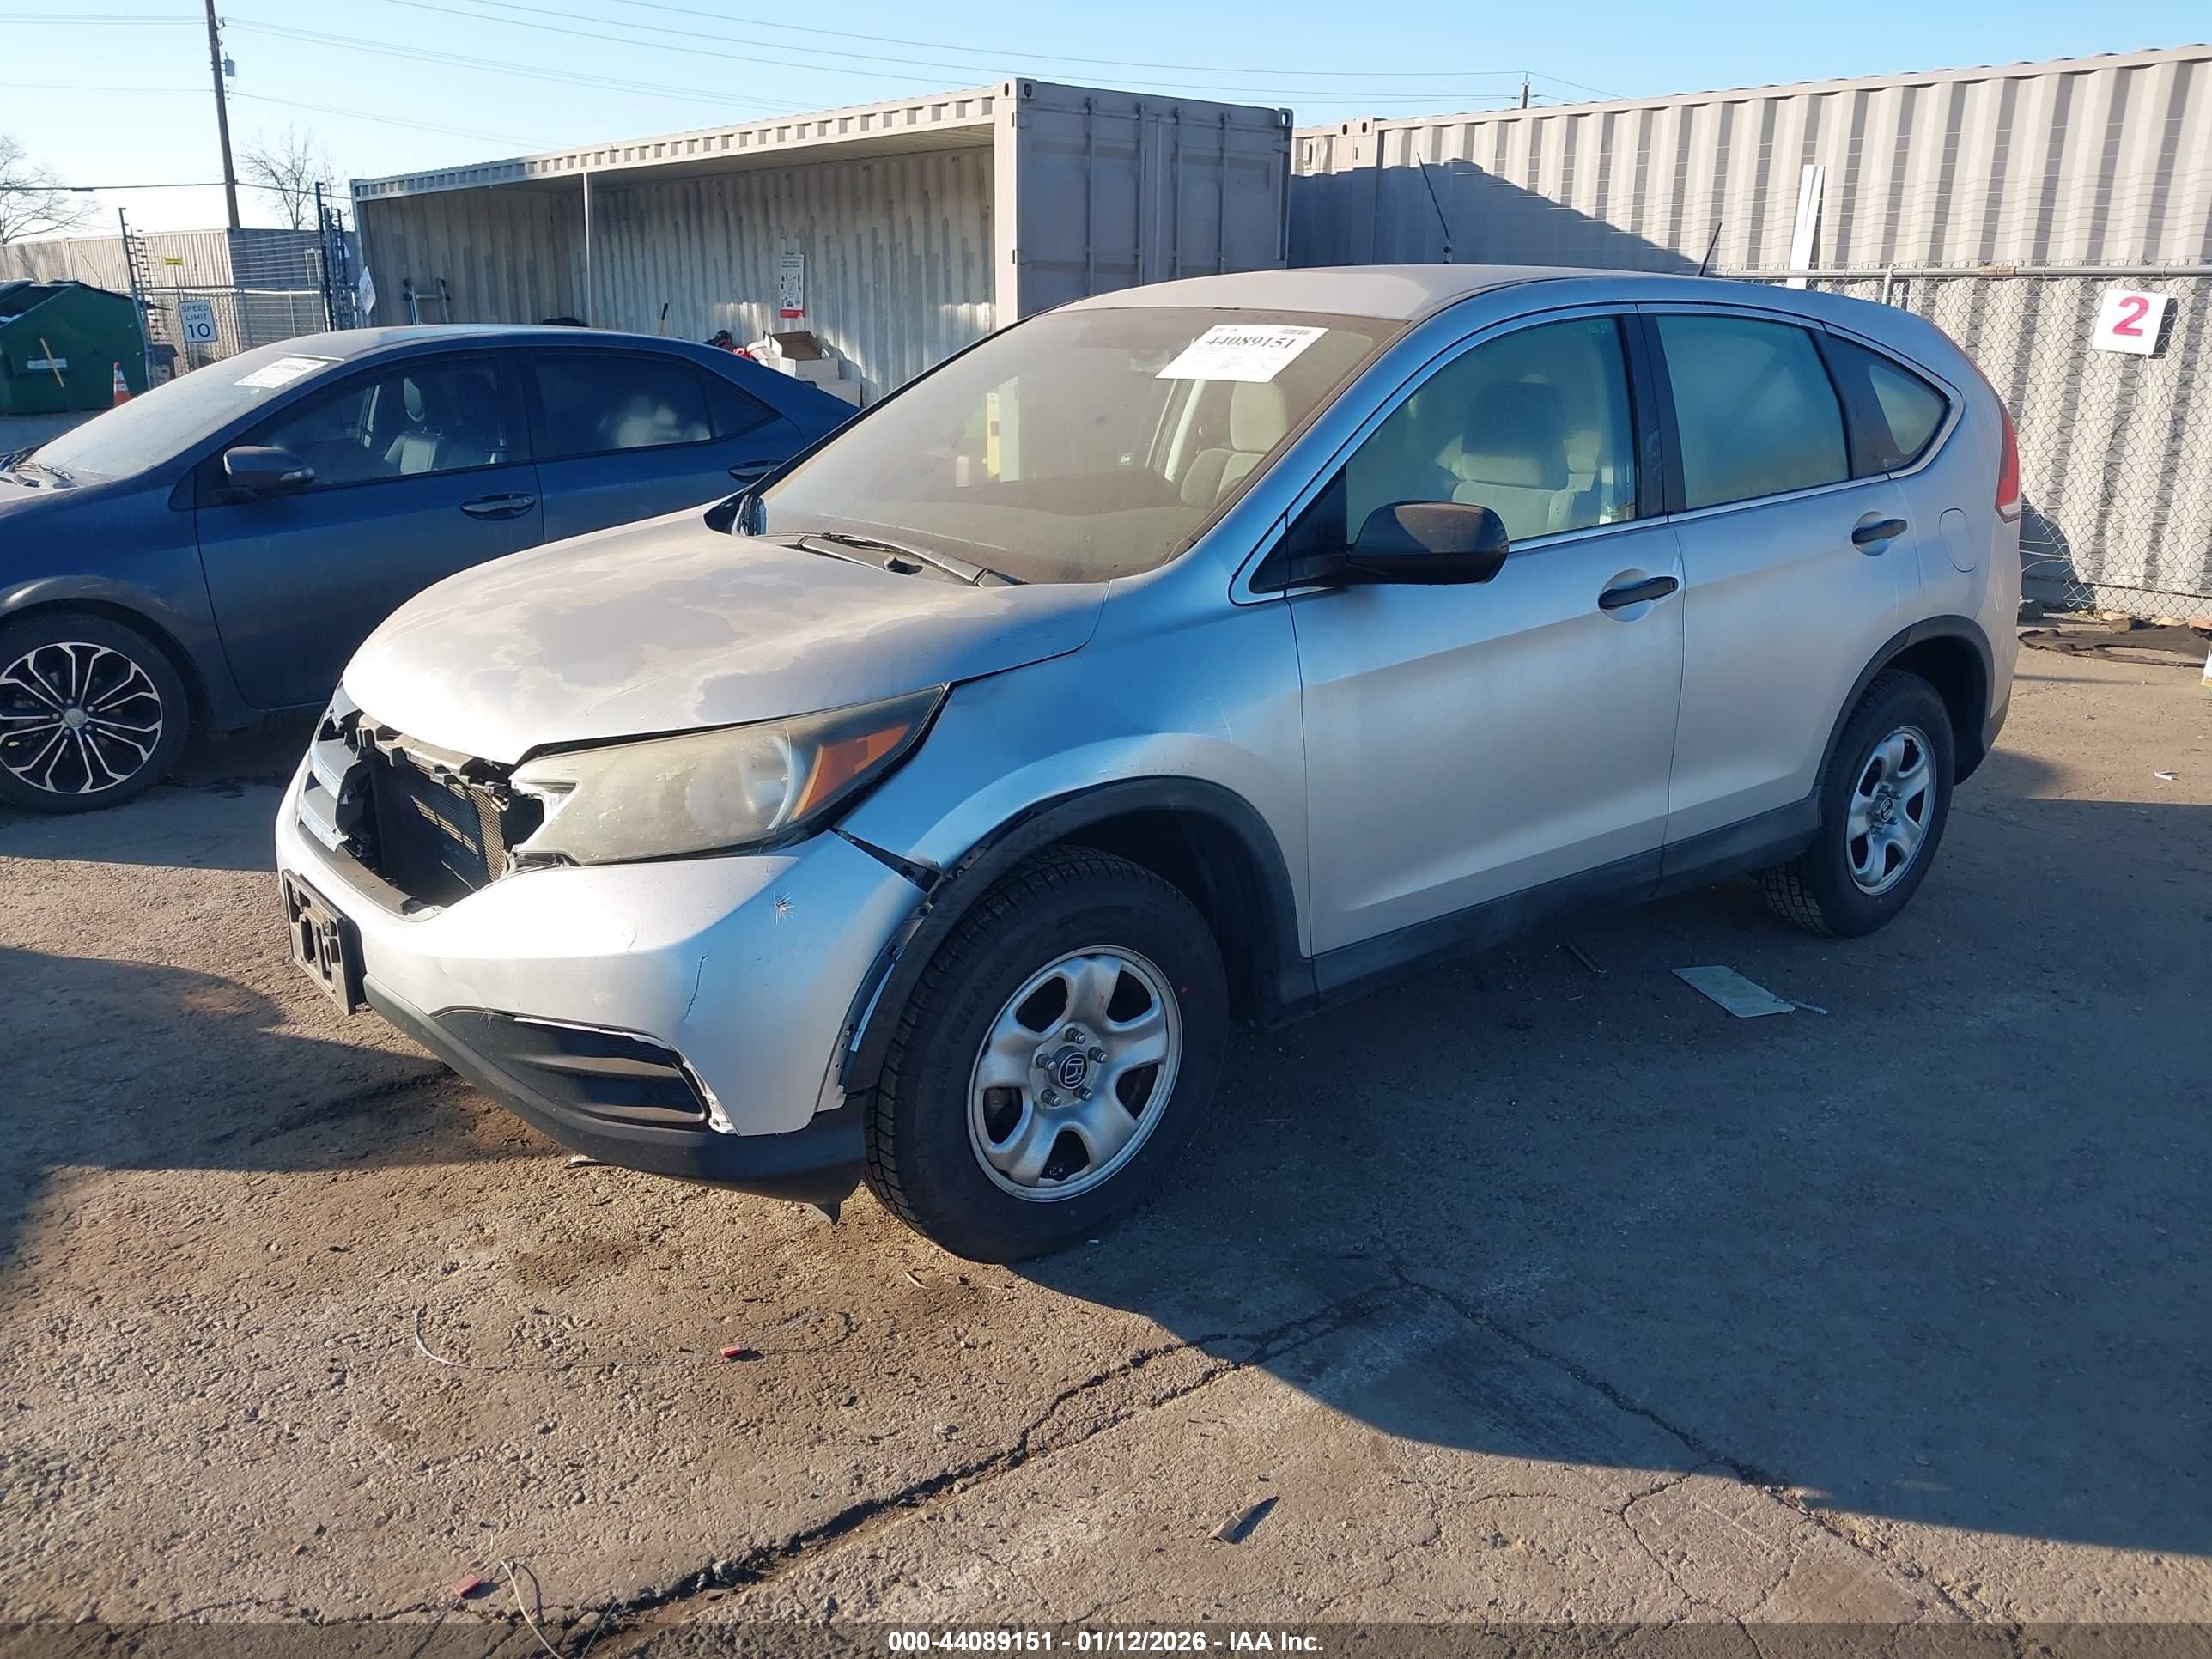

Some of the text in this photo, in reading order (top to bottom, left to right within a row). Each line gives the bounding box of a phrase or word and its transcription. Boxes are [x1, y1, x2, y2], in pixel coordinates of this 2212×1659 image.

[2112, 296, 2149, 336] 2
[187, 323, 210, 338] 10
[1206, 335, 1297, 349] 44089151
